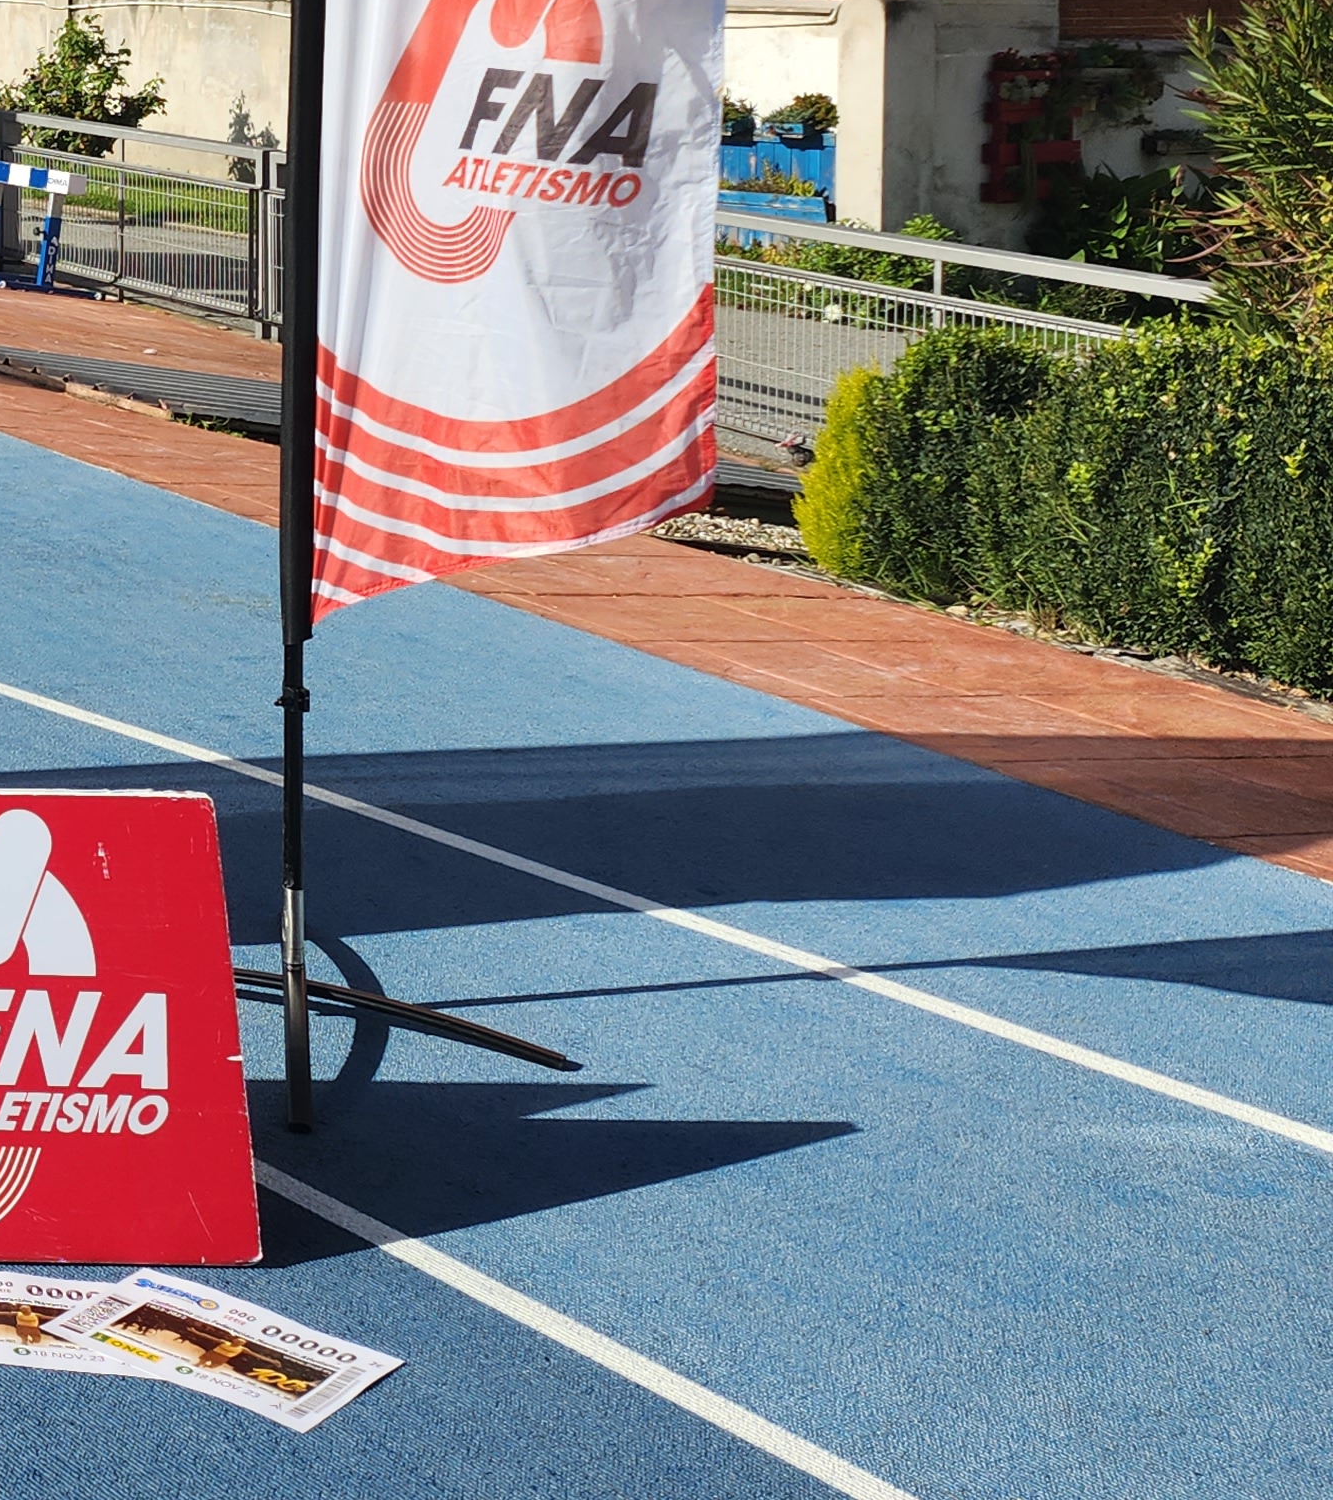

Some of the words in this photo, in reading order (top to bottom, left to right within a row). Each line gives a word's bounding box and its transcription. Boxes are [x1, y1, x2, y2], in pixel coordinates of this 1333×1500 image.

[459, 68, 658, 168] FNA
[441, 156, 641, 208] ATLETISMO
[229, 1308, 257, 1322] 000
[111, 1339, 160, 1361] ONCE
[261, 1325, 357, 1364] 00000
[51, 1351, 90, 1361] NOV.
[93, 1354, 105, 1362] 23
[212, 1376, 242, 1392] NOV.
[244, 1388, 261, 1398] 23
